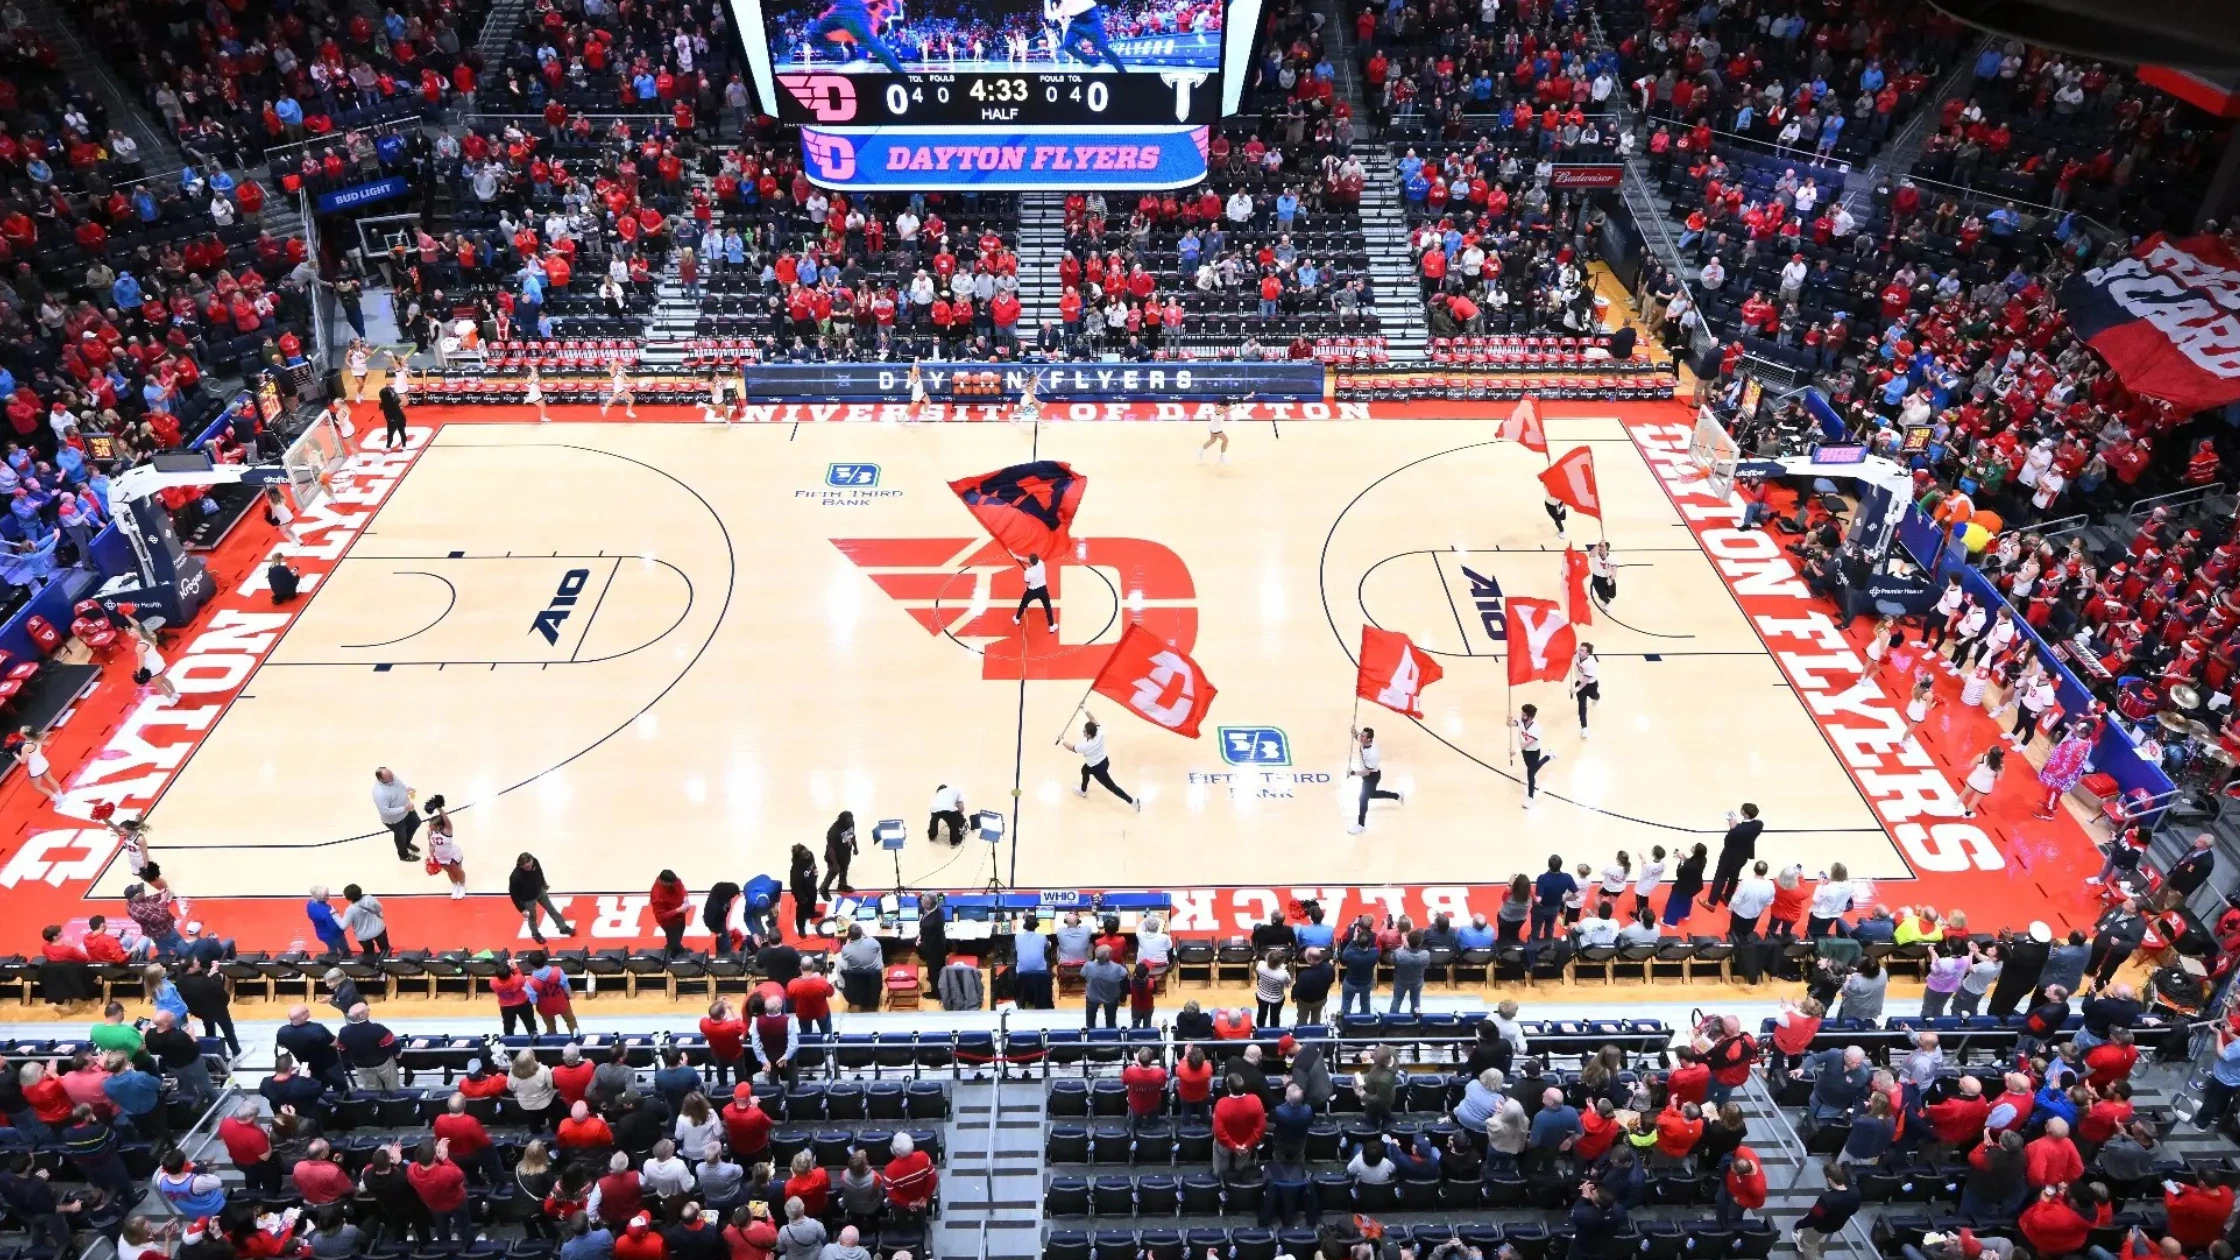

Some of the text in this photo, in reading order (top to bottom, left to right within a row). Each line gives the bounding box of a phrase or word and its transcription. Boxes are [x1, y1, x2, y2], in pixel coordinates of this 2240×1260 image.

[1040, 75, 1065, 83] FOULS
[1068, 75, 1083, 83] TOL
[912, 87, 924, 103] 4
[938, 87, 950, 103] 0
[969, 79, 1029, 102] 4:33
[1046, 87, 1058, 102] 0
[1069, 87, 1081, 102] 4
[1088, 81, 1109, 112] 0
[886, 84, 908, 115] 0
[981, 108, 1019, 120] HALF
[886, 146, 1161, 171] DAYTON FLYERS
[1554, 171, 1614, 183] Budweiser
[334, 184, 392, 205] BUD LIGHT
[879, 370, 1193, 390] DYN FLYERS
[704, 402, 1371, 423] UNIVERSIT OF DAYTON
[1909, 437, 1924, 447] 30
[91, 446, 111, 456] 30
[849, 490, 904, 498] THIRD
[179, 569, 203, 600] Kroger
[1513, 604, 1569, 670] Y
[1627, 422, 2005, 873] DAYTON FLYERS
[2, 609, 296, 888] DAYTON
[1188, 772, 1246, 785] FIFT
[1229, 787, 1294, 799] ANK
[1043, 891, 1076, 901] WHIO
